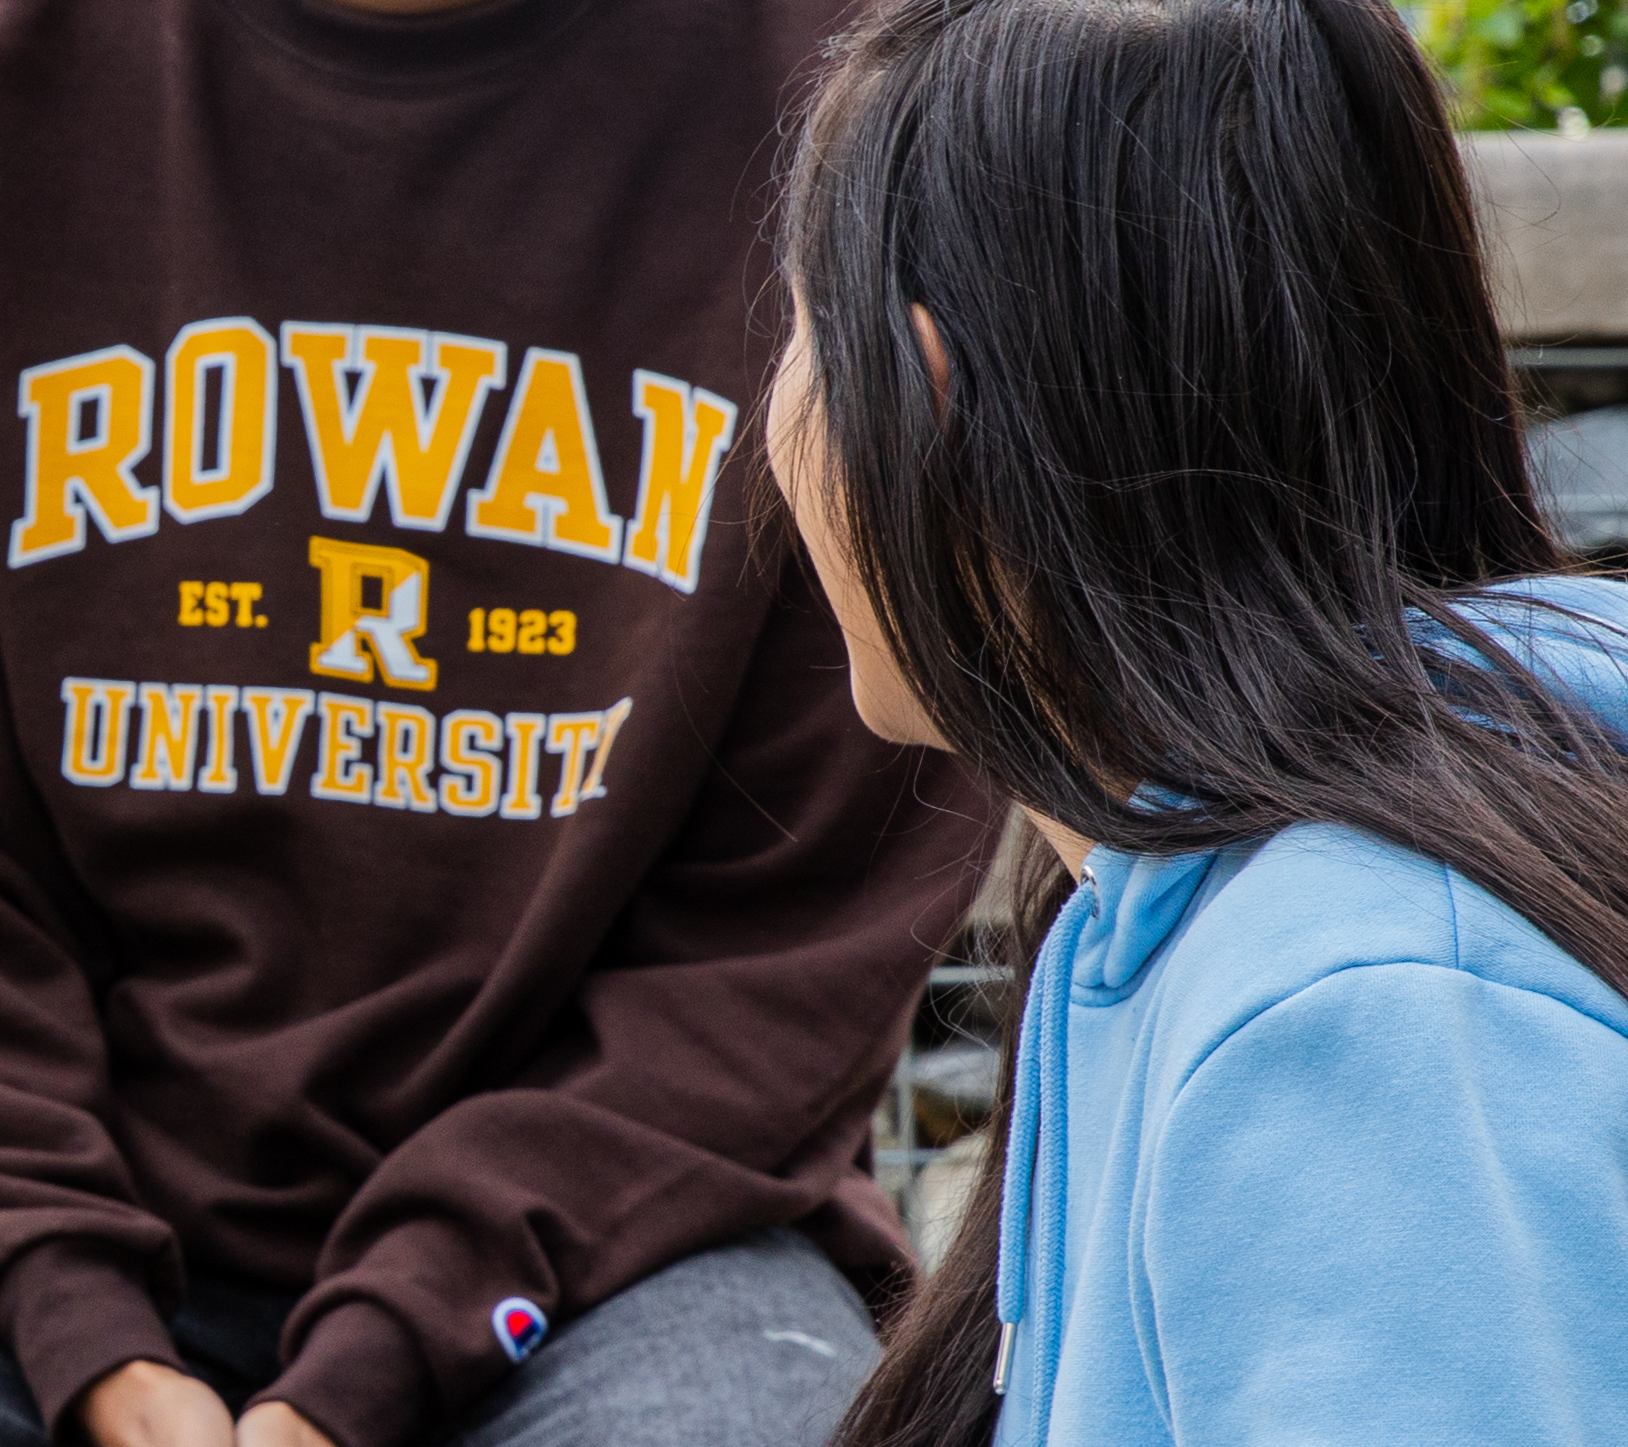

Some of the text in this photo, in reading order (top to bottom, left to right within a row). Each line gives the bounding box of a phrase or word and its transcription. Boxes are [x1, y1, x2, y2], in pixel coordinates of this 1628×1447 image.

[8, 316, 738, 594] ROWAN
[177, 535, 577, 691] EST. R 1923
